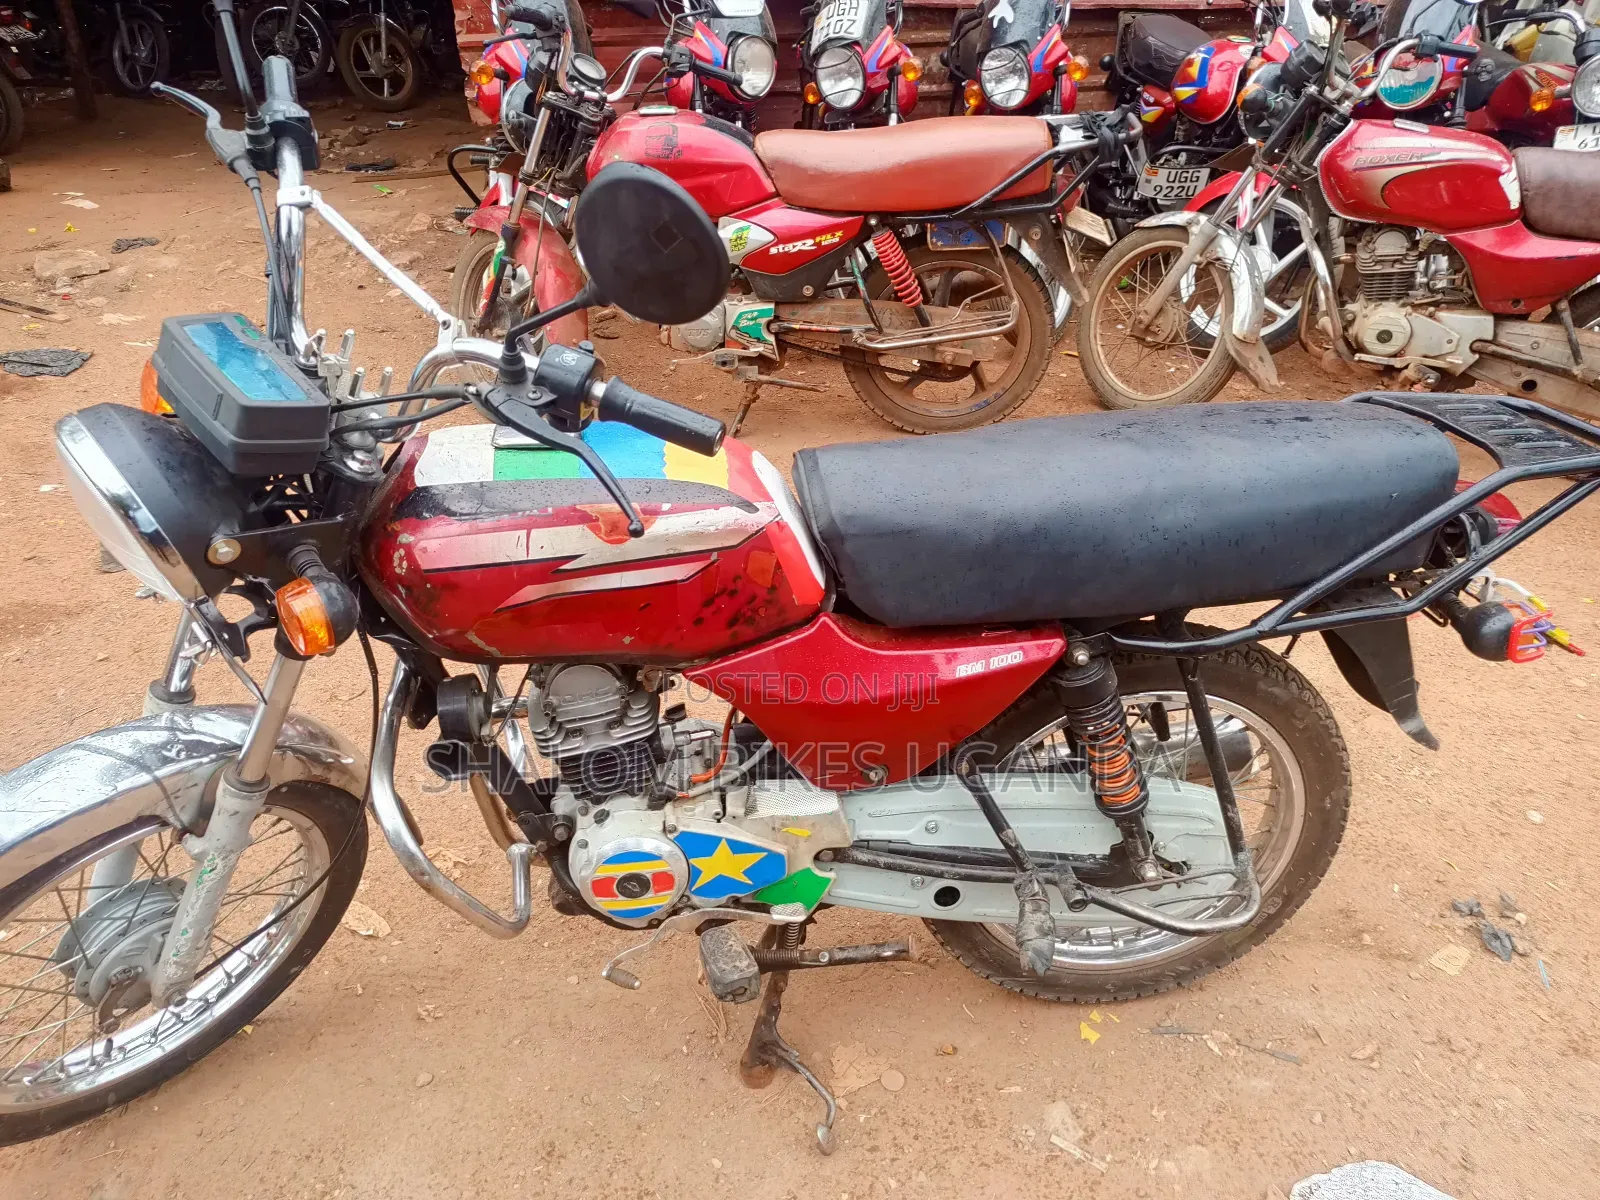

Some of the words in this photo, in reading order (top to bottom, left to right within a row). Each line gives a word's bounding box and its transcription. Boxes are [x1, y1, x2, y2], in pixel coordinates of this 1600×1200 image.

[1352, 152, 1425, 166] BOXER
[1166, 170, 1201, 184] UGG
[1153, 184, 1198, 198] 922U
[956, 660, 986, 678] BM
[989, 651, 1023, 670] 100
